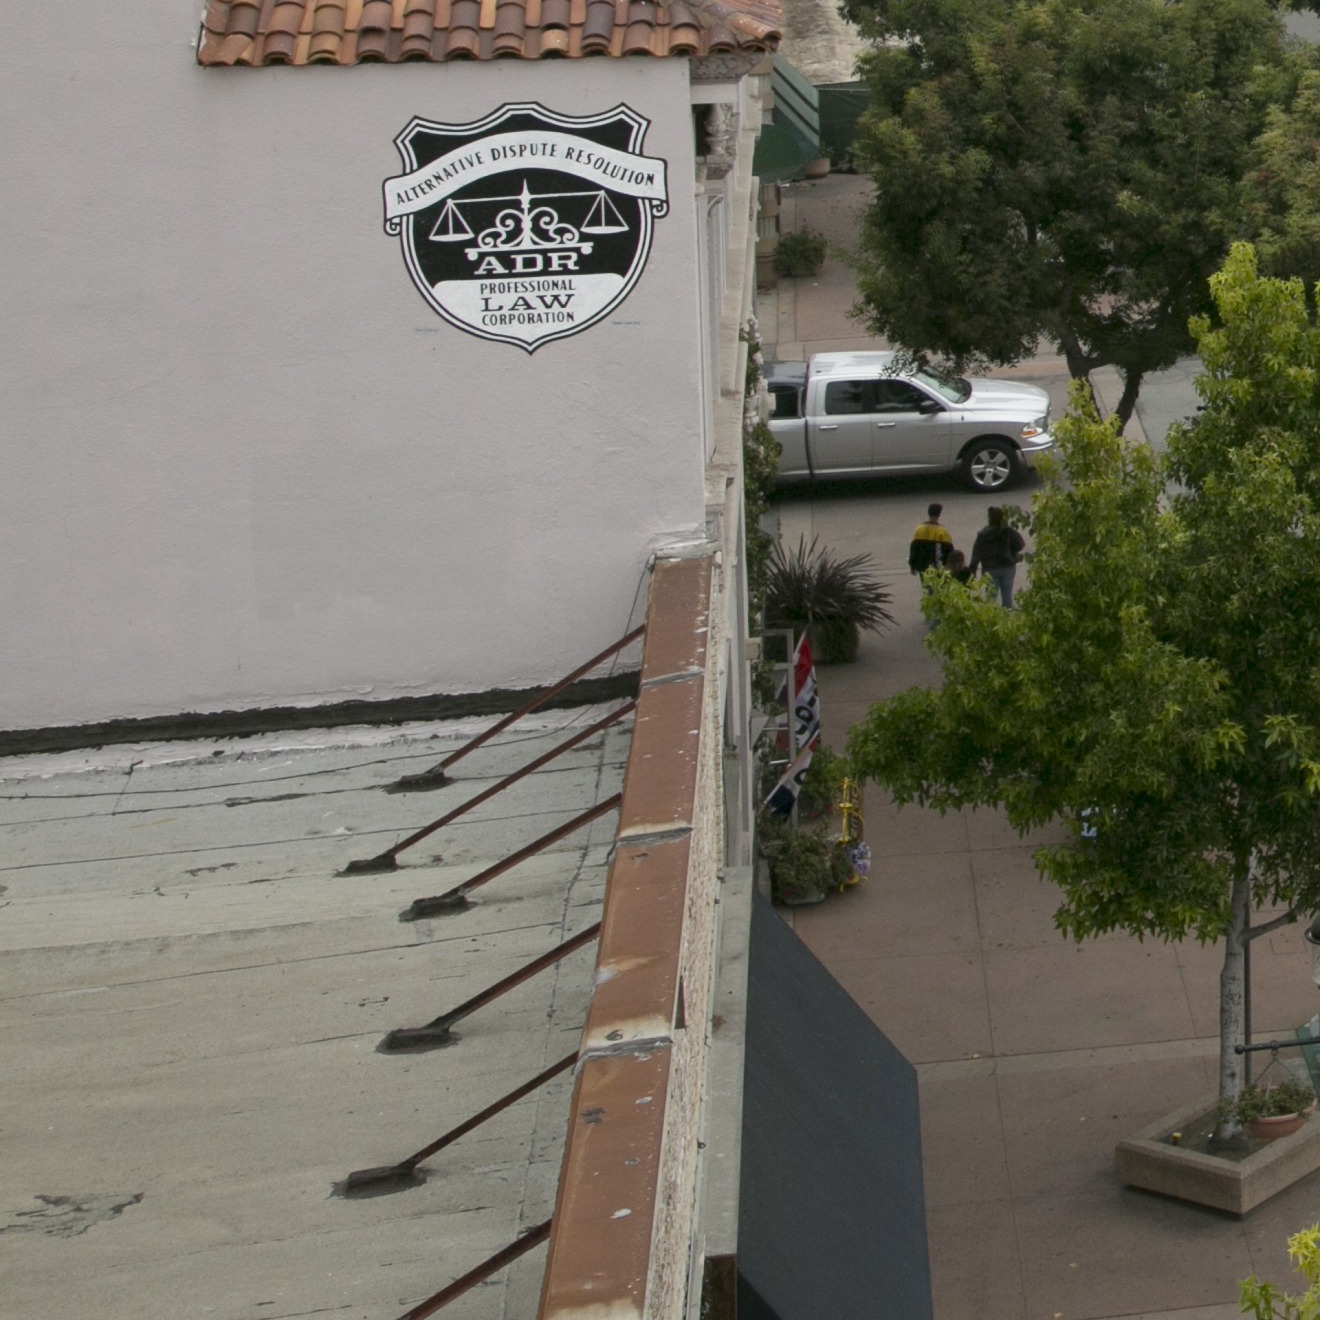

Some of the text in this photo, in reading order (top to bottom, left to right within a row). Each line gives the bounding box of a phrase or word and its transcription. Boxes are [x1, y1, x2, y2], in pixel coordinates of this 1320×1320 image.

[396, 142, 655, 206] ALTERNATIVE DISPUTE RESOLUTION
[474, 251, 580, 275] ADR
[480, 278, 576, 295] PROFESSIONAL
[481, 293, 575, 312] LAW
[482, 311, 575, 326] CORPORATION
